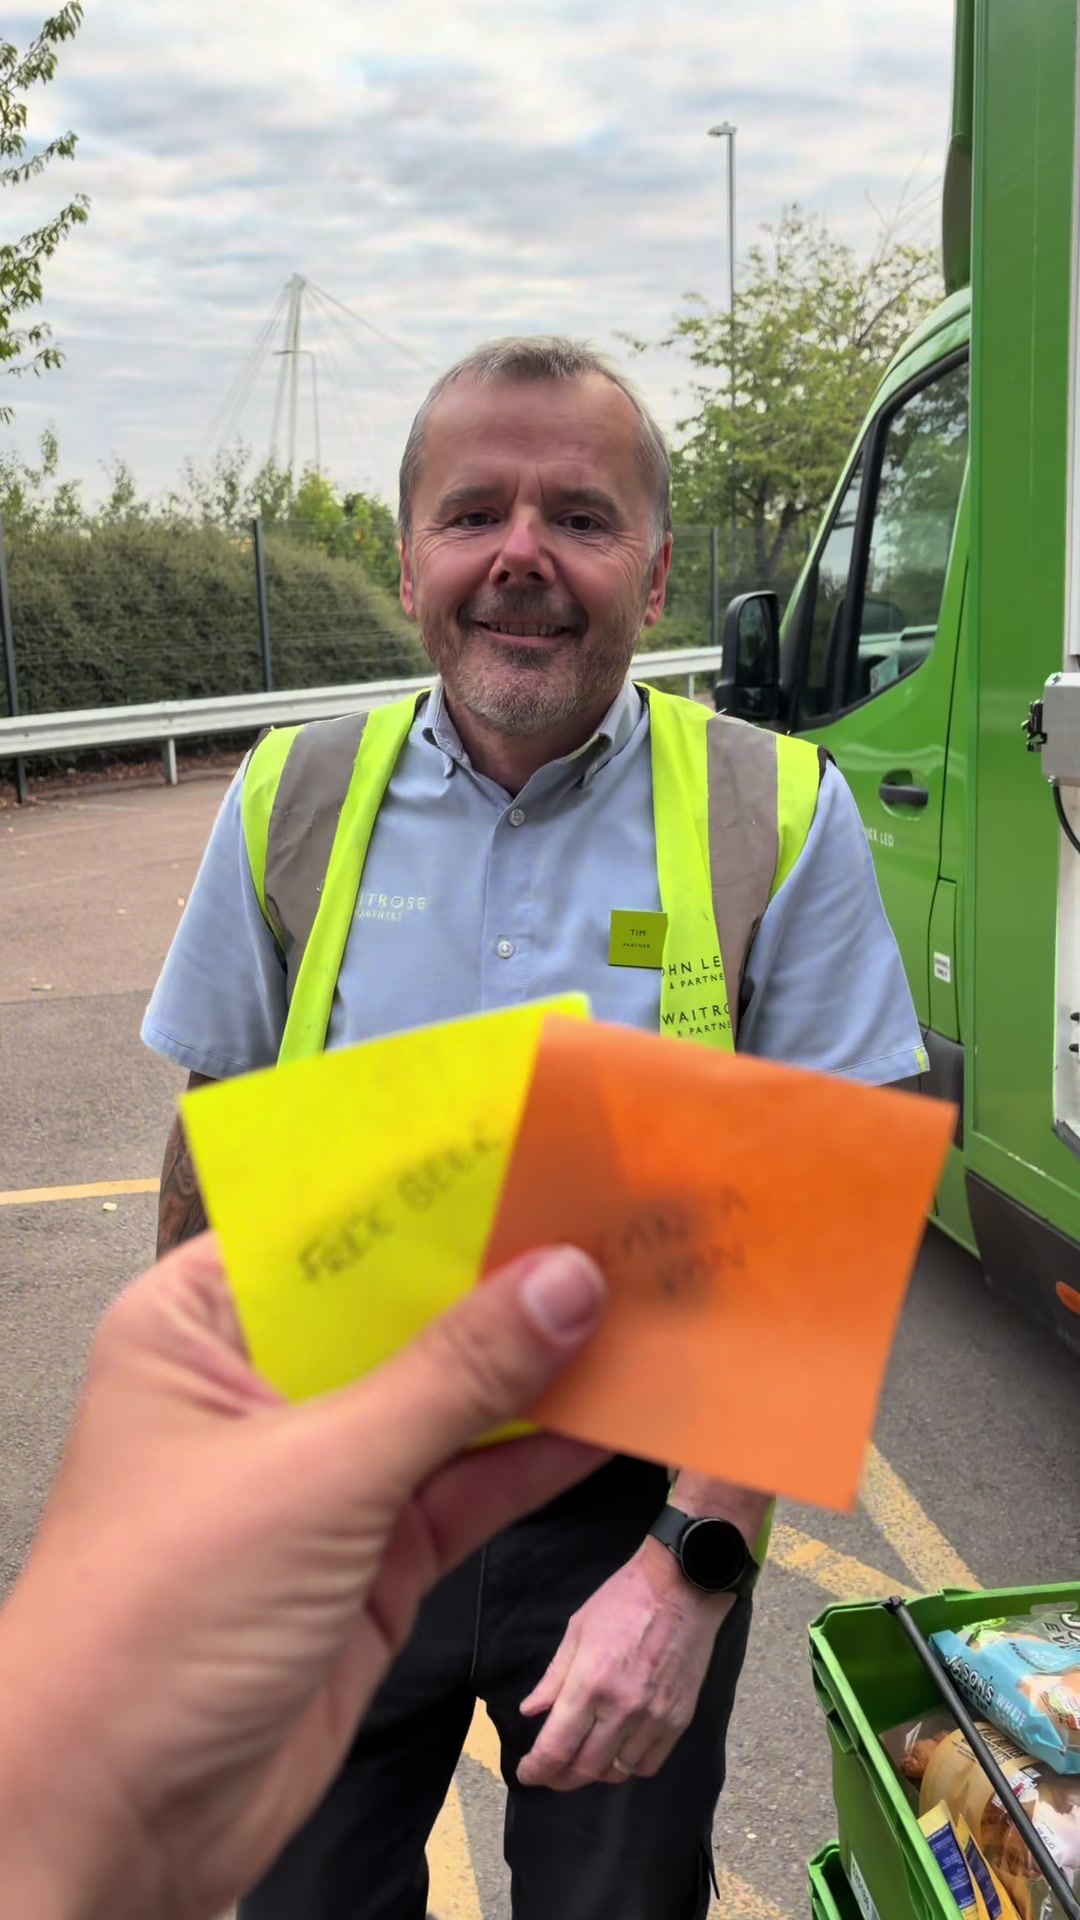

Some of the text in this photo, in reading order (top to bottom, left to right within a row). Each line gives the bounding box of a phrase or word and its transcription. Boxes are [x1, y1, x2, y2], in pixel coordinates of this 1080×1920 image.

[630, 929, 646, 937] TIM
[661, 955, 721, 977] HN LE
[681, 972, 724, 988] PARTNE
